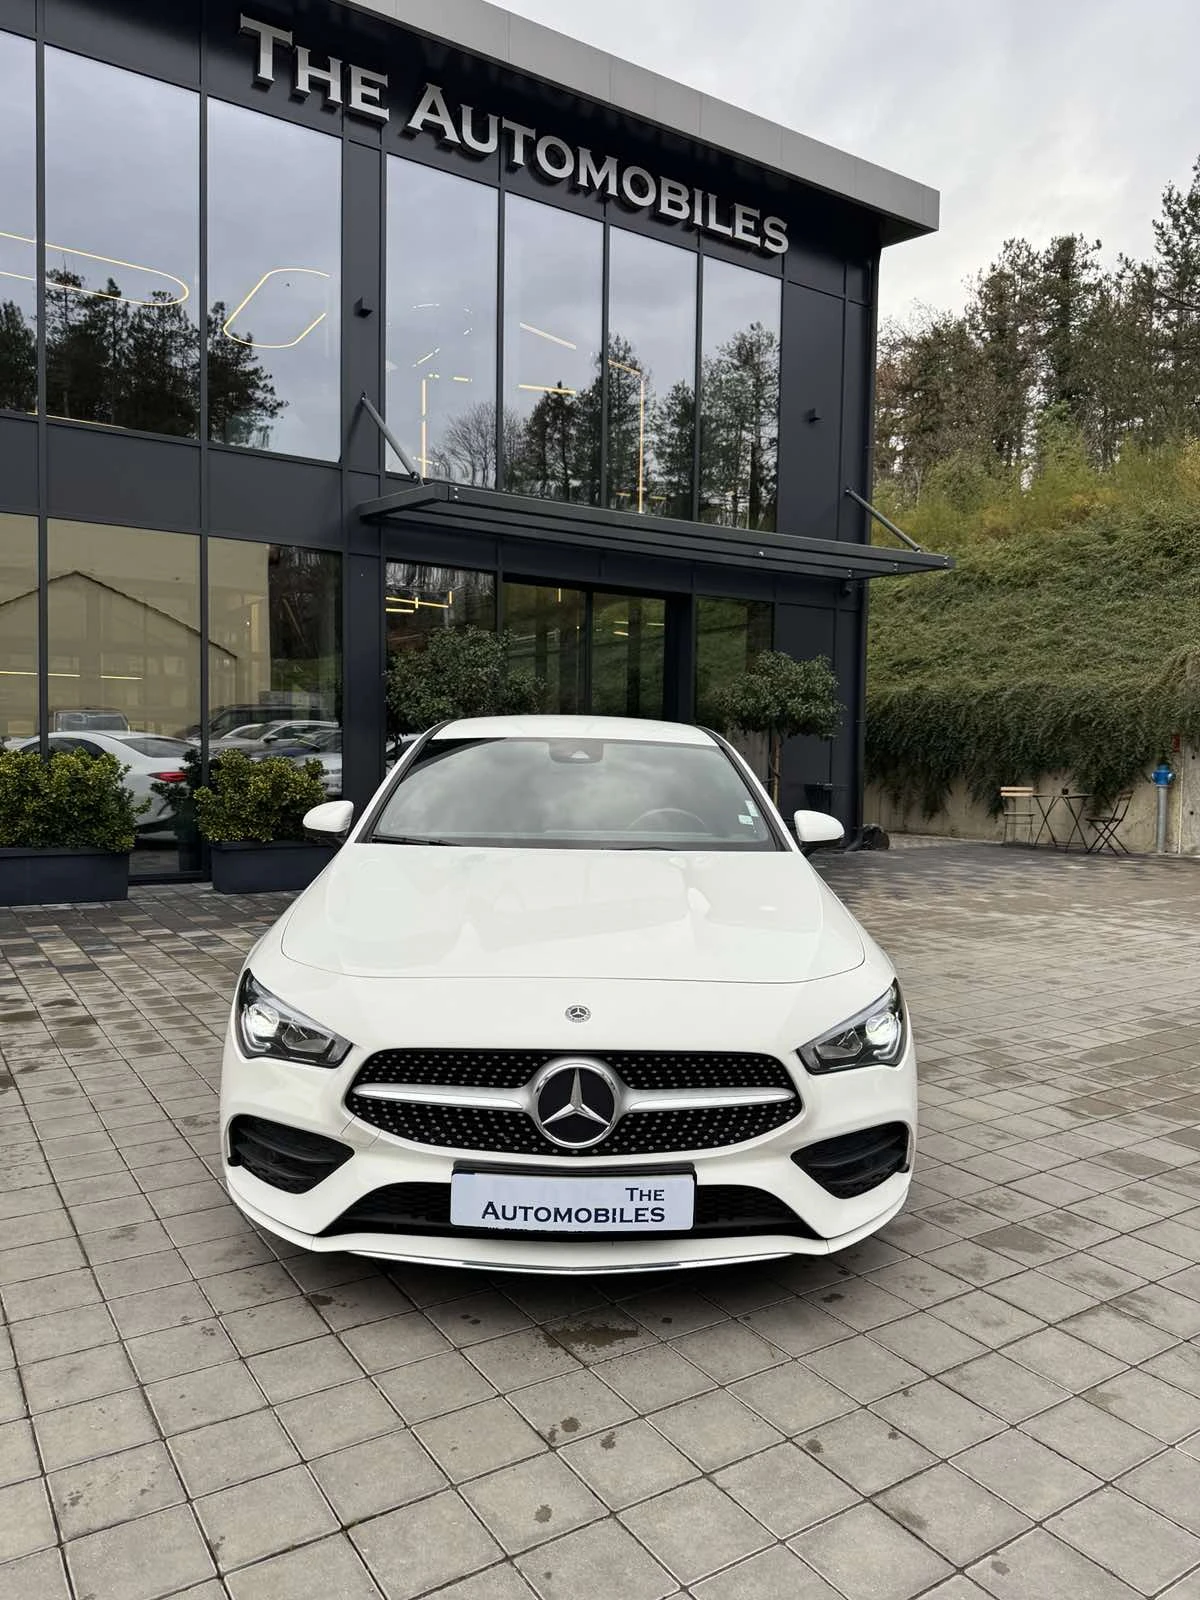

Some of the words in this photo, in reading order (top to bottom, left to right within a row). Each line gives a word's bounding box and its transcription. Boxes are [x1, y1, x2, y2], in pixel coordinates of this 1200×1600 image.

[239, 14, 390, 122] THE
[406, 83, 790, 255] AUTOMOBILES
[625, 1187, 665, 1202] THE
[481, 1201, 665, 1223] AUTOMOBILES
